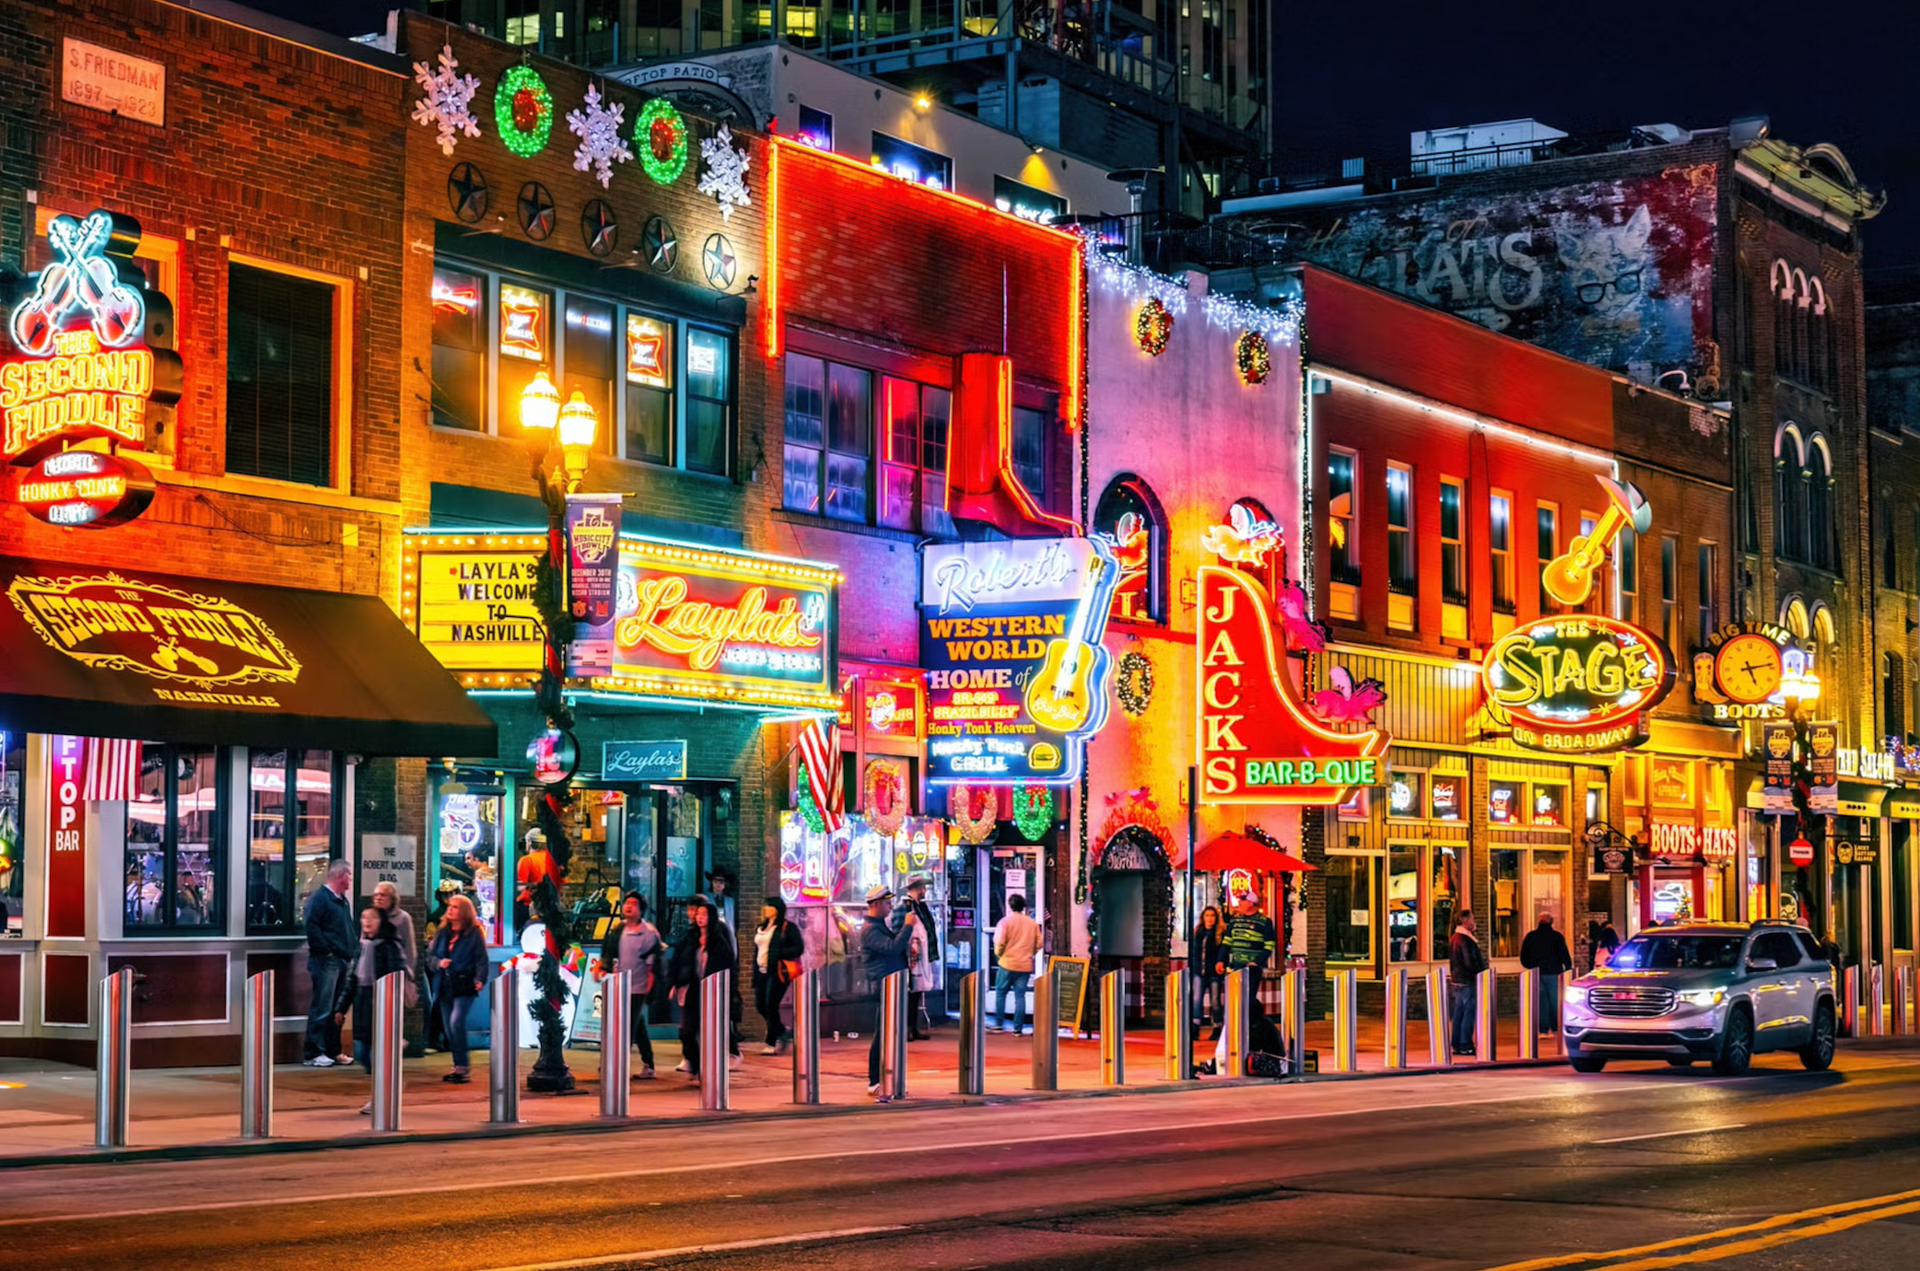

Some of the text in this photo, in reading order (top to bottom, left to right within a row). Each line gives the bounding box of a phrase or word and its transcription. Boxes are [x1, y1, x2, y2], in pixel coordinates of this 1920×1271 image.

[673, 66, 715, 79] PATIO
[53, 330, 92, 355] THE
[0, 350, 154, 408] SECOND
[4, 392, 144, 454] FIDDLE
[19, 476, 120, 502] HONKY TONK
[460, 562, 536, 580] LAYLA'S
[936, 543, 1077, 616] Robert's
[115, 589, 143, 602] THE
[487, 604, 507, 621] TO
[615, 576, 821, 670] Layla's
[29, 593, 285, 667] SECOND FIDDLE
[452, 624, 542, 641] NASHVILLE
[927, 613, 1066, 639] WESTERN
[1554, 621, 1590, 638] THE
[1709, 621, 1791, 646] BIG TIME
[945, 638, 1048, 661] WORLD
[929, 666, 1033, 693] HOME of
[1495, 634, 1657, 706] STAGE
[152, 687, 281, 708] NASHVILLE
[1203, 586, 1248, 795] JACKS
[1713, 703, 1786, 719] BOOTS
[927, 722, 1036, 738] Honky Tonk Heaven
[1513, 725, 1633, 749] ON BROADWAY
[606, 749, 682, 776] Layla's
[1246, 759, 1377, 785] BAR-B-QUE
[56, 830, 80, 851] BAR
[383, 847, 396, 857] THE
[1650, 824, 1736, 856] BOOTS HATS
[363, 860, 414, 871] ROBERT MOORE
[1231, 877, 1249, 890] OPEN
